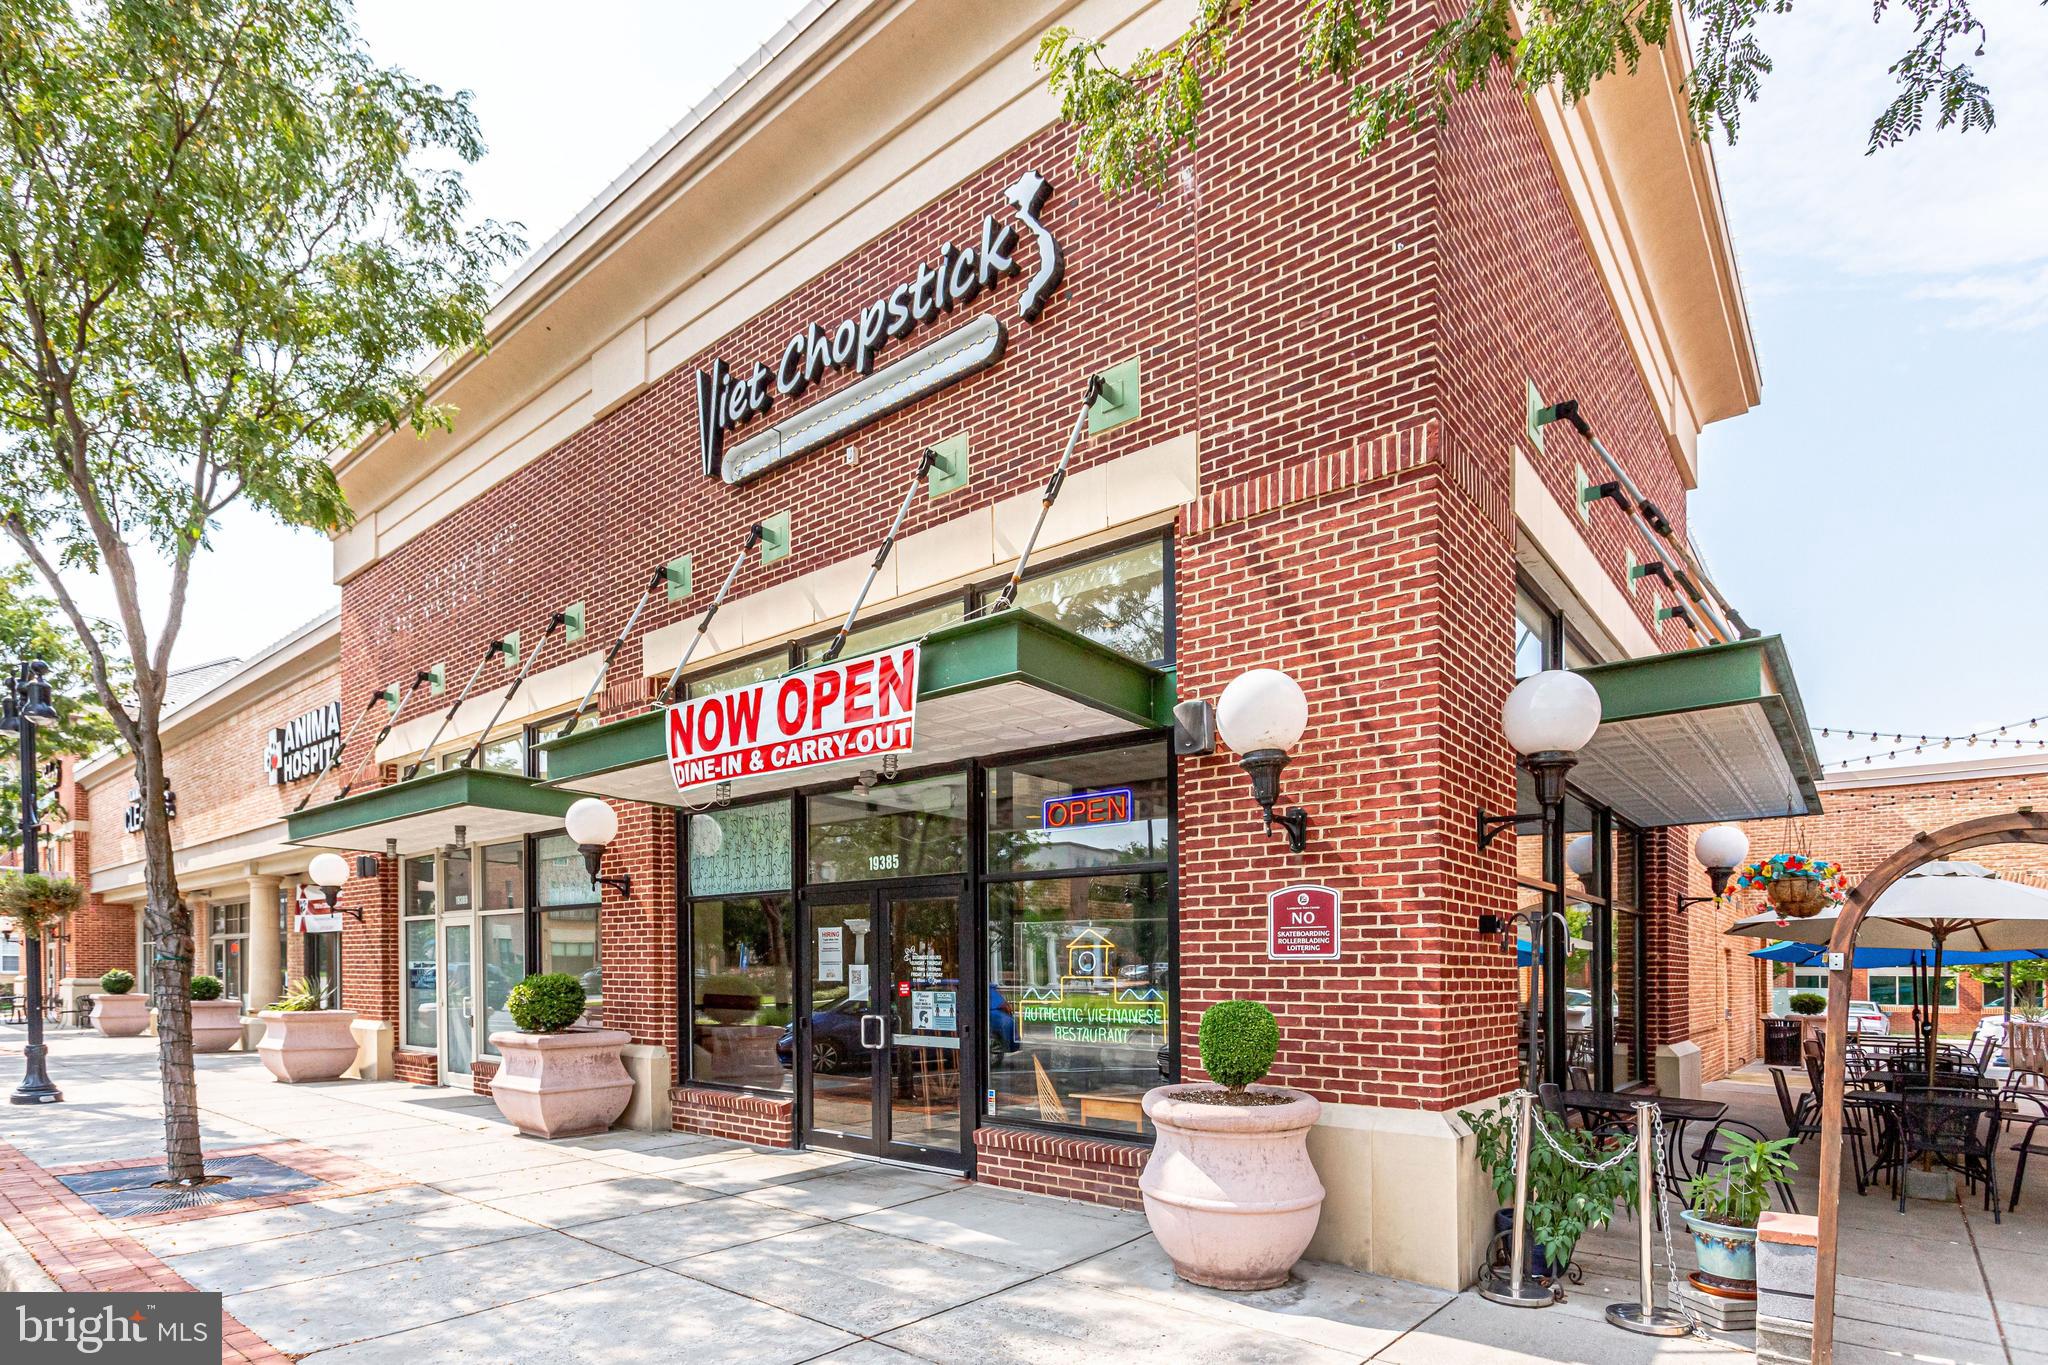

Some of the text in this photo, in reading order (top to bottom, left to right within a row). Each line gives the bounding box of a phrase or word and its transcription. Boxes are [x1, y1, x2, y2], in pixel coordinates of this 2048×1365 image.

[696, 357, 773, 478] Viet
[670, 648, 914, 759] NOW OPEN
[675, 721, 912, 785] DINE-IN & CARRY-OUT
[1048, 794, 1126, 827] OPEN
[869, 854, 899, 871] 19385
[1292, 911, 1315, 925] NO
[1024, 1007, 1162, 1024] AUTHENTIC VIETNAMESE
[1054, 1026, 1130, 1043] RESTAURANT
